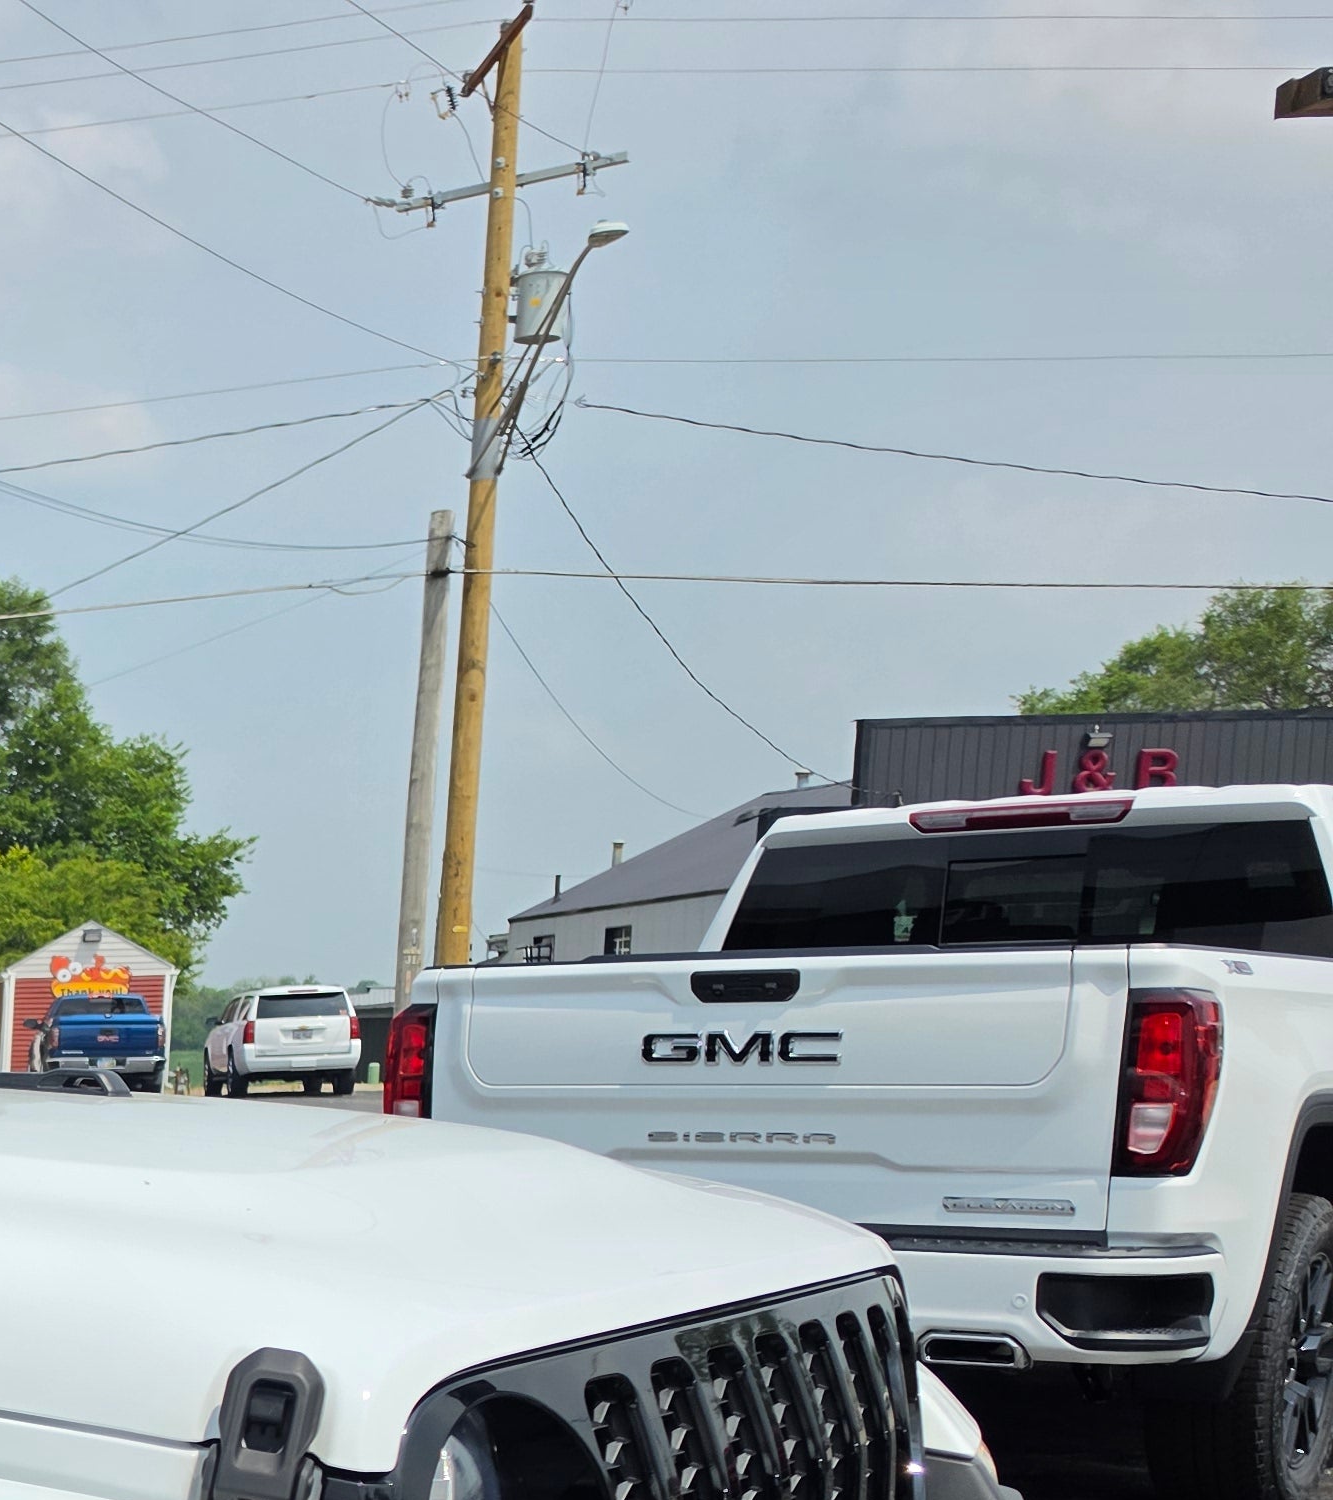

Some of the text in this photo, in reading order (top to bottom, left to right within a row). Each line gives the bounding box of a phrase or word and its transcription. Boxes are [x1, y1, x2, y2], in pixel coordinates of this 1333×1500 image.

[1018, 749, 1058, 796] J
[1073, 748, 1117, 793] &
[641, 1029, 845, 1066] GMC
[647, 1130, 837, 1145] SIERRA
